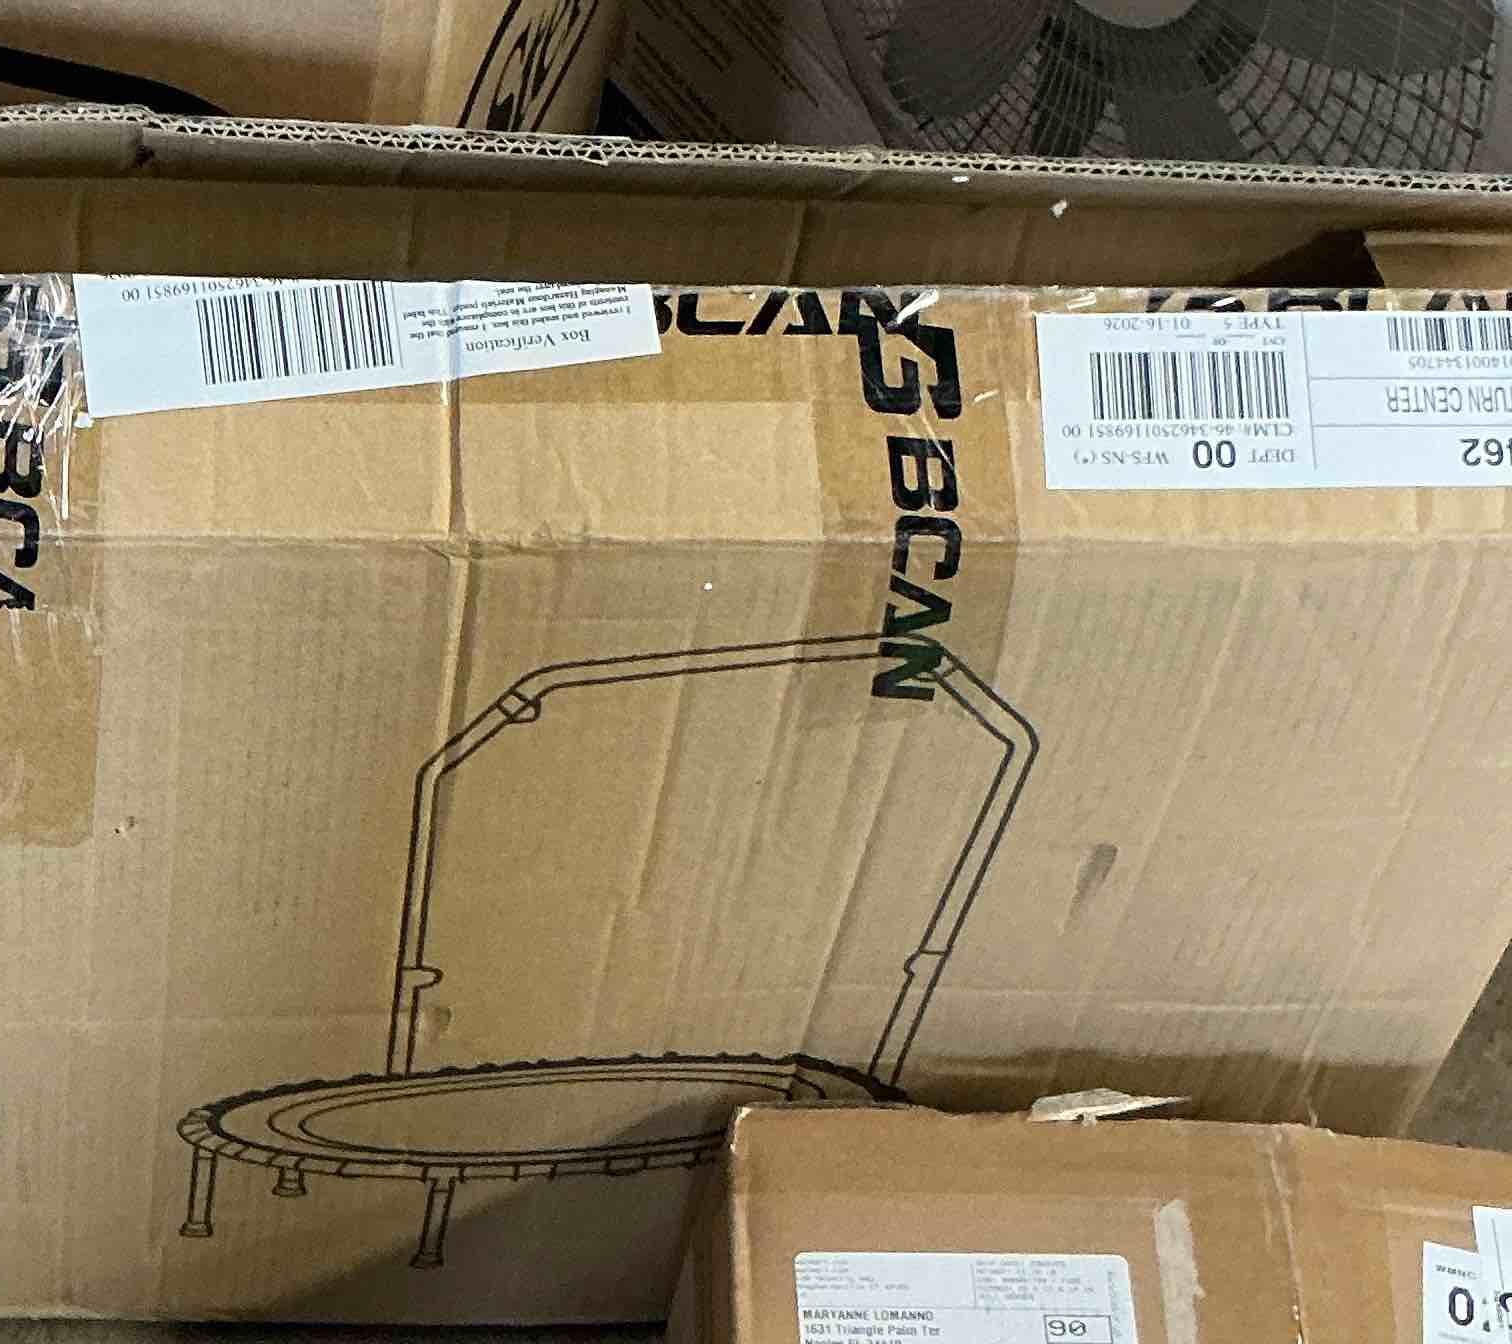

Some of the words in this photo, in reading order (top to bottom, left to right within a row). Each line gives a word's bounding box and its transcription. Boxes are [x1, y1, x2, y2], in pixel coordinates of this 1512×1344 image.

[465, 331, 557, 352] Verification
[562, 327, 591, 344] Box
[1385, 386, 1463, 414] CENTER
[1192, 440, 1237, 470] 00
[1248, 447, 1296, 465] DEPT
[1047, 1319, 1088, 1337] 90
